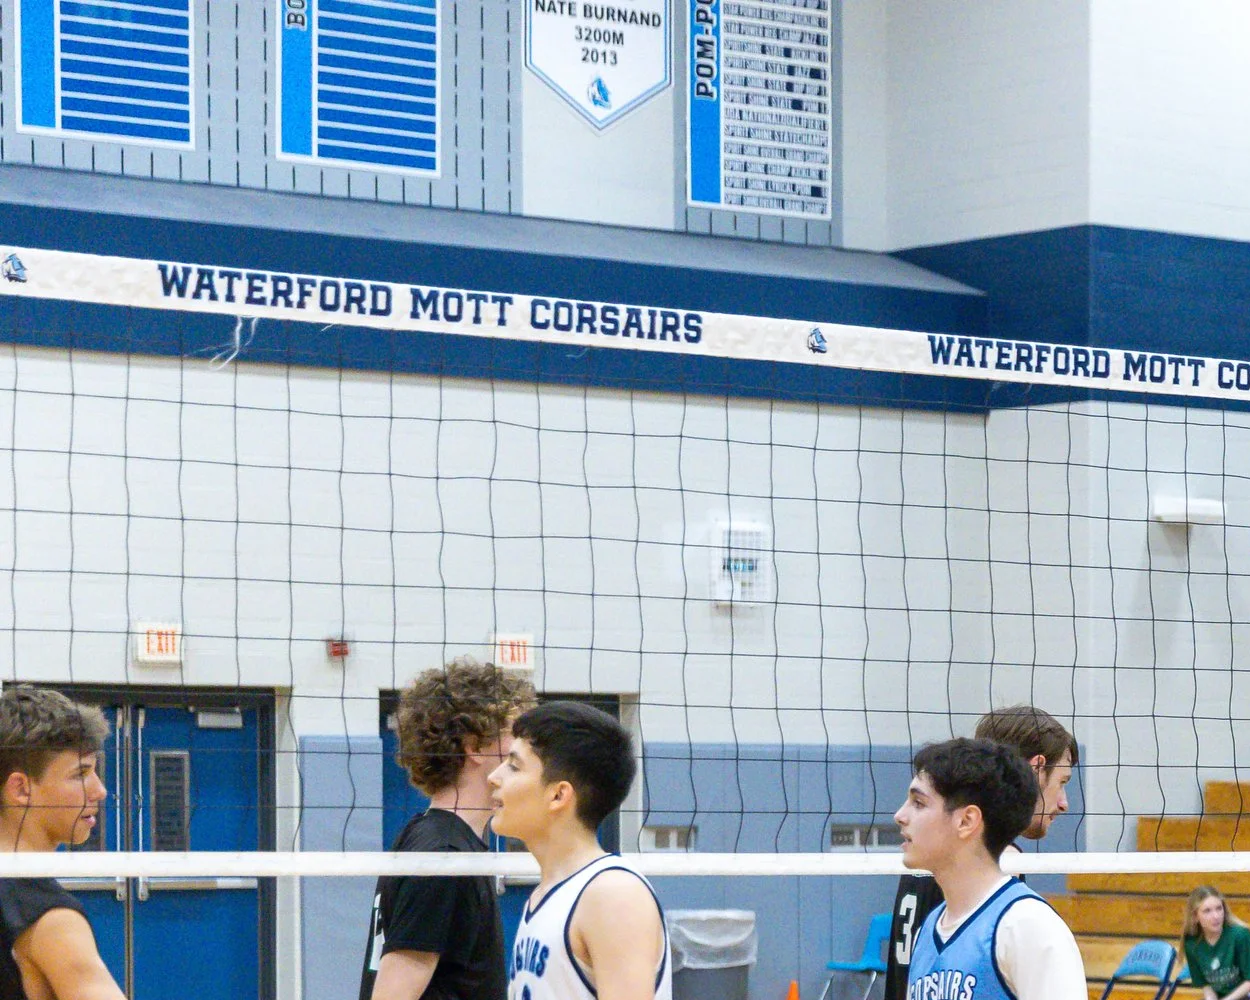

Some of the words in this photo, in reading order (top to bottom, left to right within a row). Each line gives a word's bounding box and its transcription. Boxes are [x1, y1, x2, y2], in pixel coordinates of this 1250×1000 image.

[535, 0, 577, 17] NATE
[583, 4, 662, 28] BURNAND
[575, 25, 625, 46] 3200M
[696, 0, 714, 98] POM-P
[581, 48, 618, 65] 2013
[158, 264, 392, 317] WATERFORD
[410, 288, 514, 326] MOTT
[530, 299, 703, 344] CORSAIRS
[928, 335, 1111, 379] WATERFORD
[1123, 352, 1205, 386] MOTT
[146, 629, 176, 655] EXIT
[500, 640, 527, 664] EXIT
